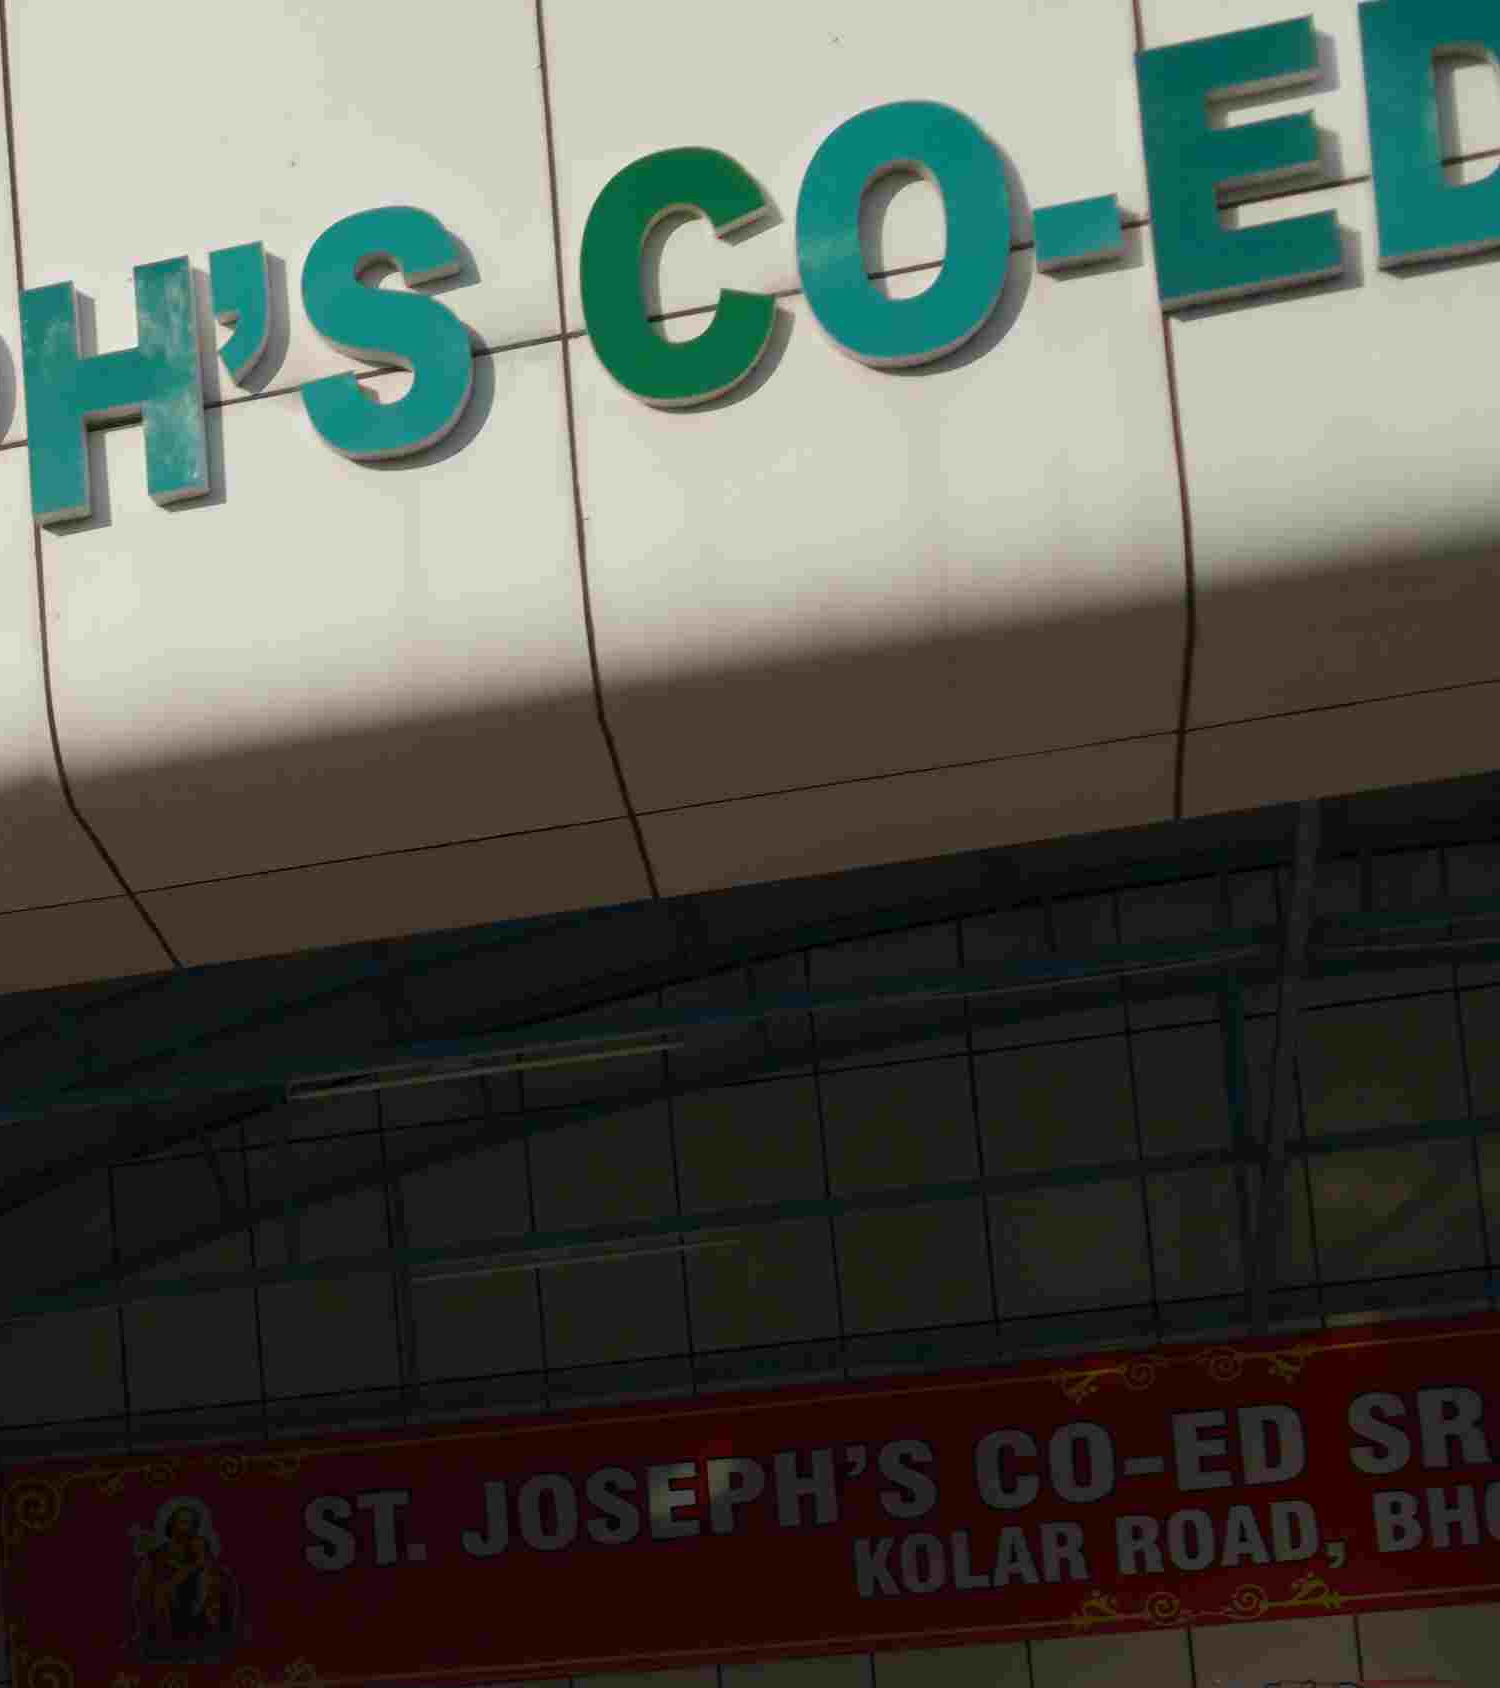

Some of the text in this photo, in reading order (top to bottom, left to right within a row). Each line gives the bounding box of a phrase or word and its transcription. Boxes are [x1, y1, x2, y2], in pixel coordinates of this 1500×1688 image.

[580, 0, 1500, 407] CO-ED
[303, 1384, 1492, 1572] ST. JOSEPH’S CO-ED SR
[852, 1519, 1090, 1600] KOLAR
[1115, 1498, 1348, 1576] ROAD,
